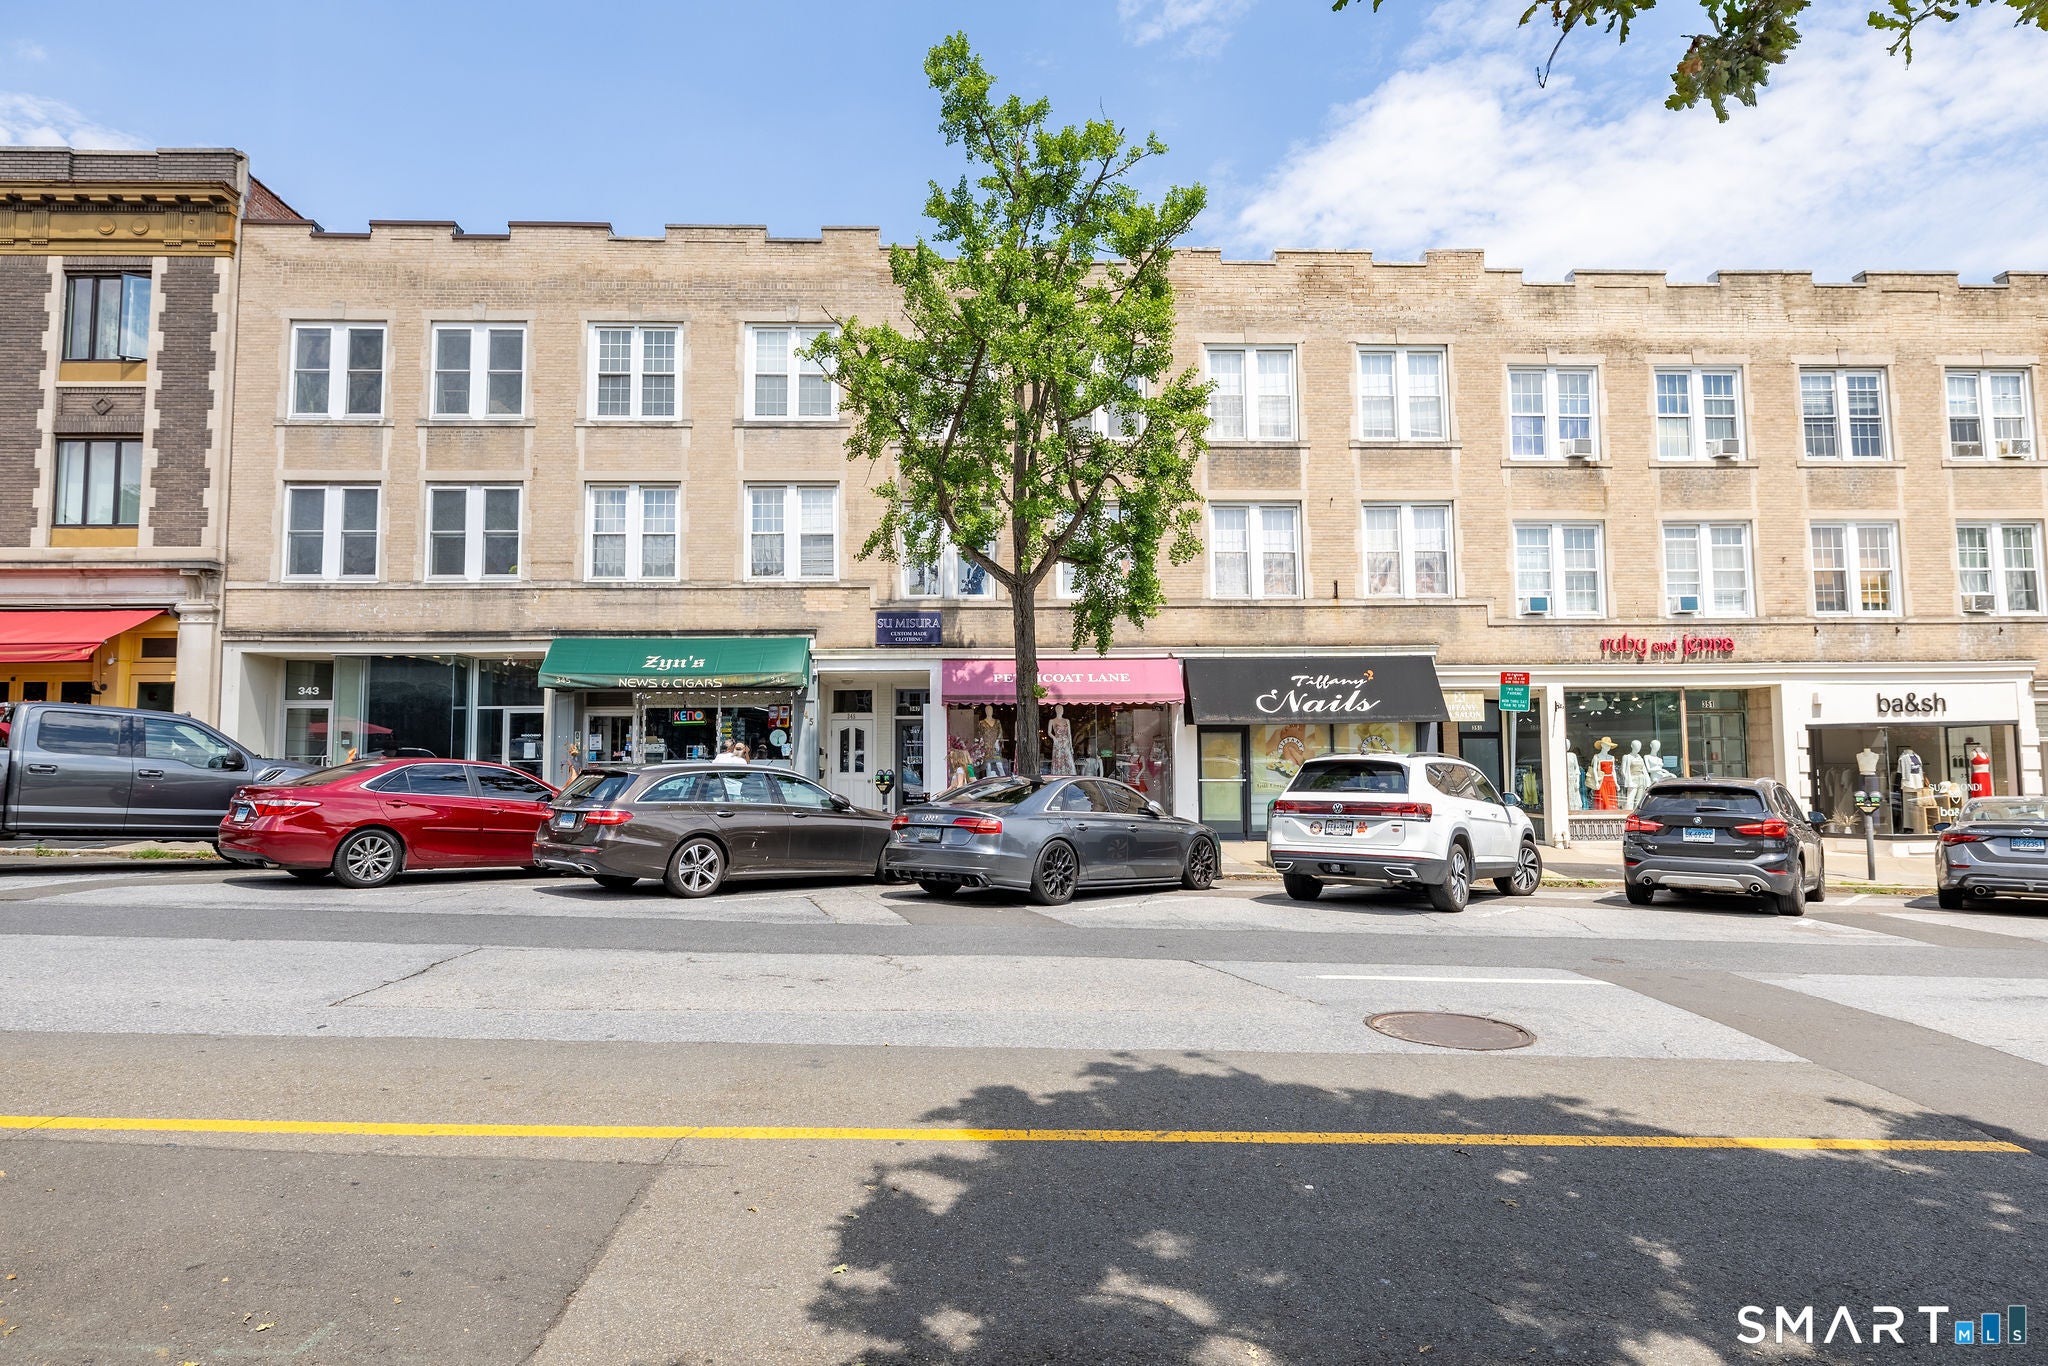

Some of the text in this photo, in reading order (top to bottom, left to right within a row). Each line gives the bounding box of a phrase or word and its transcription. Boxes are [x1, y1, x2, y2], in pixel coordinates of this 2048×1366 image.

[877, 618, 941, 629] SU MISURA
[1601, 632, 1735, 657] ruby and jenna
[642, 655, 706, 671] Zyn's
[555, 676, 571, 684] 345
[618, 678, 723, 688] NEWS & CIGARS
[770, 675, 786, 684] 345
[993, 673, 1131, 683] PEICOAT LANE
[1291, 675, 1368, 689] Tiffany
[298, 686, 320, 695] 343
[1256, 689, 1381, 714] Nails
[1702, 700, 1714, 708] 351
[1876, 692, 1947, 713] ba&sh
[673, 710, 704, 721] KENO
